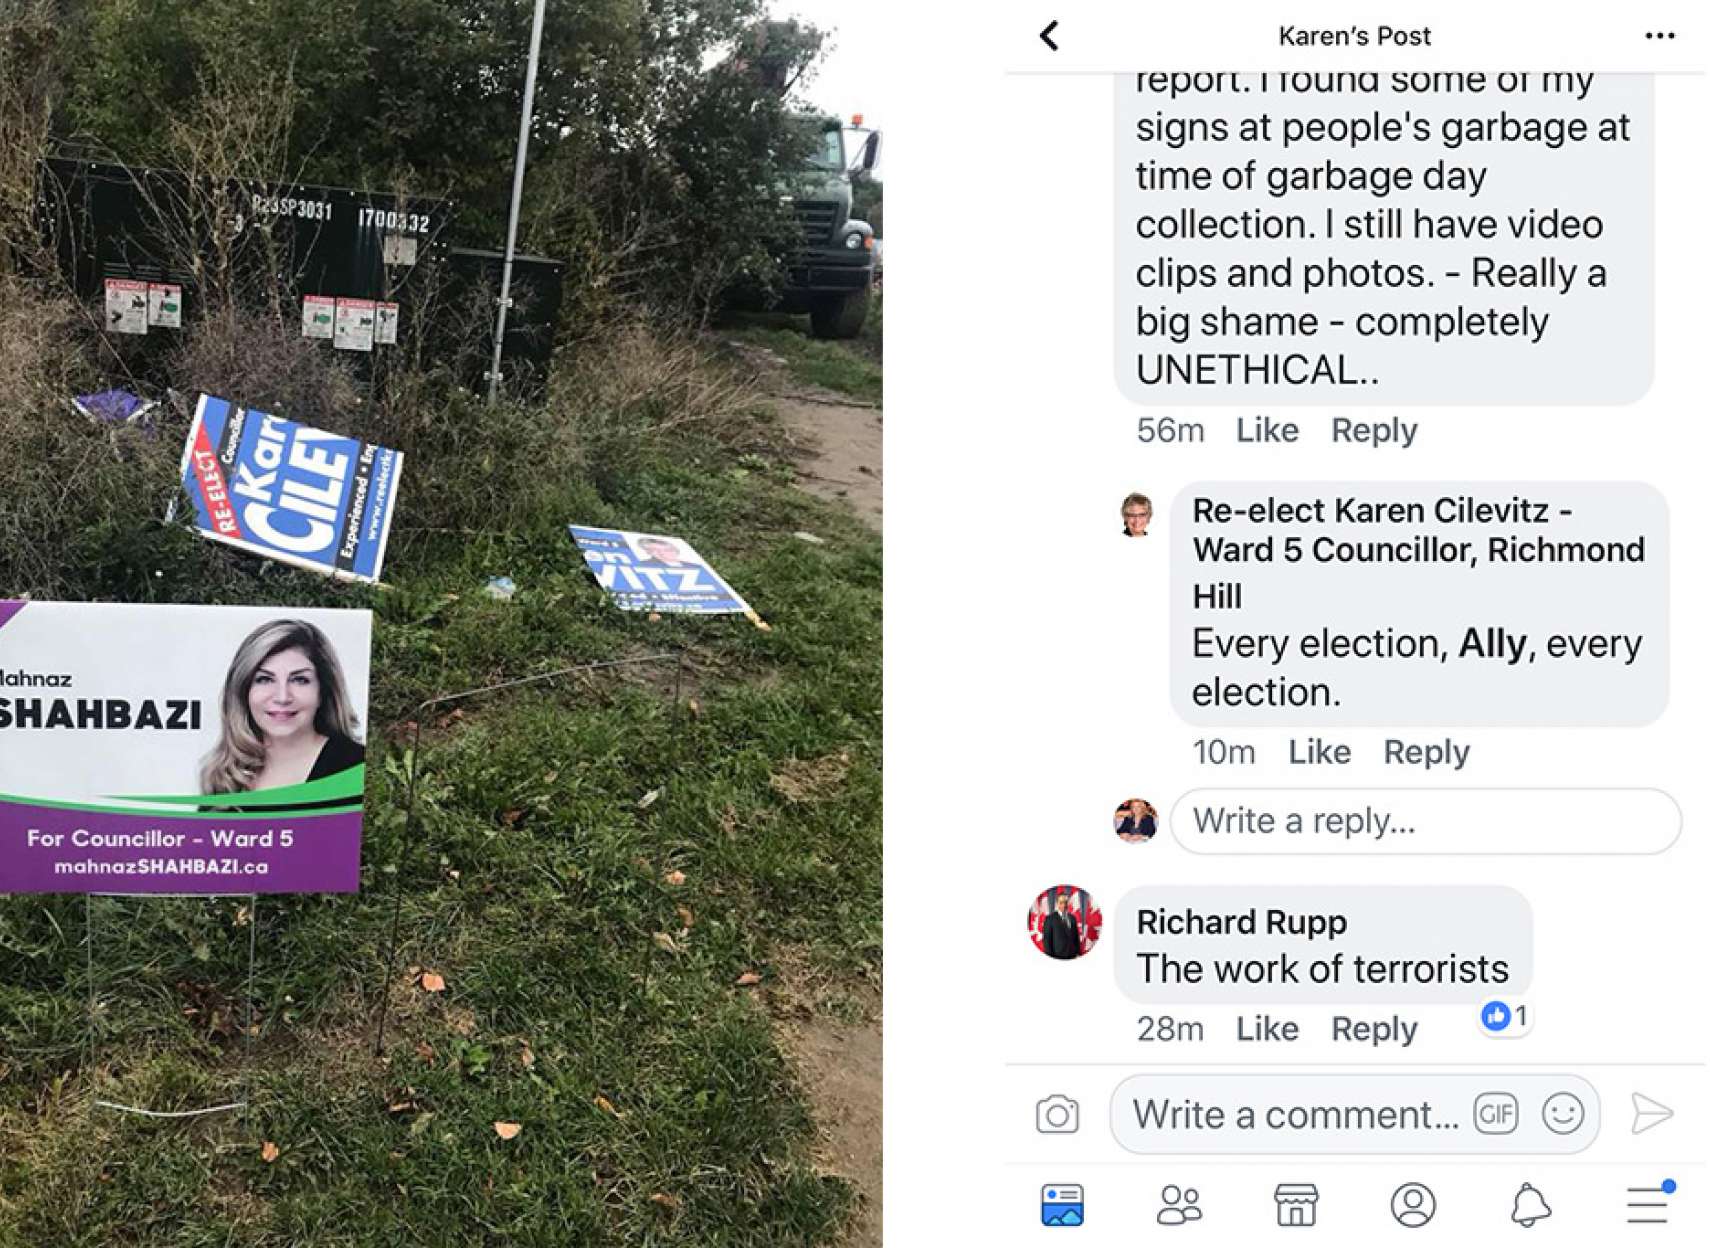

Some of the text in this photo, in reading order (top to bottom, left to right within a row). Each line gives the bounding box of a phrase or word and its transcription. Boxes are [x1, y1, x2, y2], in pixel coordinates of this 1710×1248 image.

[1377, 24, 1432, 47] Post
[1136, 73, 1251, 100] report.
[1279, 73, 1379, 94] found
[1390, 73, 1487, 94] some
[1496, 73, 1530, 94] of
[1542, 73, 1595, 100] my
[1136, 110, 1631, 149] signs at people's garbage at
[1134, 158, 1489, 198] time of garbage day
[1136, 207, 1604, 240] collection. I still have video
[1136, 255, 1218, 294] clips
[1227, 255, 1292, 288] and
[1304, 256, 1434, 294] photos.
[1472, 255, 1578, 294] Really
[1587, 264, 1608, 288] a
[1136, 304, 1191, 343] big
[1200, 304, 1319, 337] shame
[1355, 304, 1551, 343] completely
[1137, 352, 1379, 385] UNETHICAL..
[1137, 414, 1419, 449] 56m Like Reply
[194, 450, 238, 534] RE-ELECT
[340, 475, 369, 559] Experienced
[1193, 496, 1326, 524] Re-elect
[1335, 496, 1425, 524] Karen
[1434, 494, 1549, 524] Cilevitz
[1192, 534, 1646, 568] Ward 5 Councillor, Richmond
[1193, 581, 1242, 610] Hill
[1193, 626, 1644, 666] Every election, Ally, every
[1192, 675, 1341, 708] election.
[0, 698, 202, 730] SHAHBAZI
[1193, 737, 1471, 771] 10m Like Reply
[27, 829, 65, 848] For
[71, 829, 186, 848] Councillor
[210, 829, 274, 848] Ward
[279, 829, 294, 848] 5
[1192, 805, 1416, 841] Write a reply...
[54, 858, 269, 875] mahnazSHAHBAZI.ca
[1137, 907, 1348, 941] Richard Rupp
[1135, 951, 1510, 984] The work of terrorists
[1137, 1013, 1419, 1048] 28m Like Reply
[1515, 1004, 1526, 1027] 1
[1132, 1097, 1459, 1130] Write a comment...
[1479, 1104, 1513, 1124] GIF
